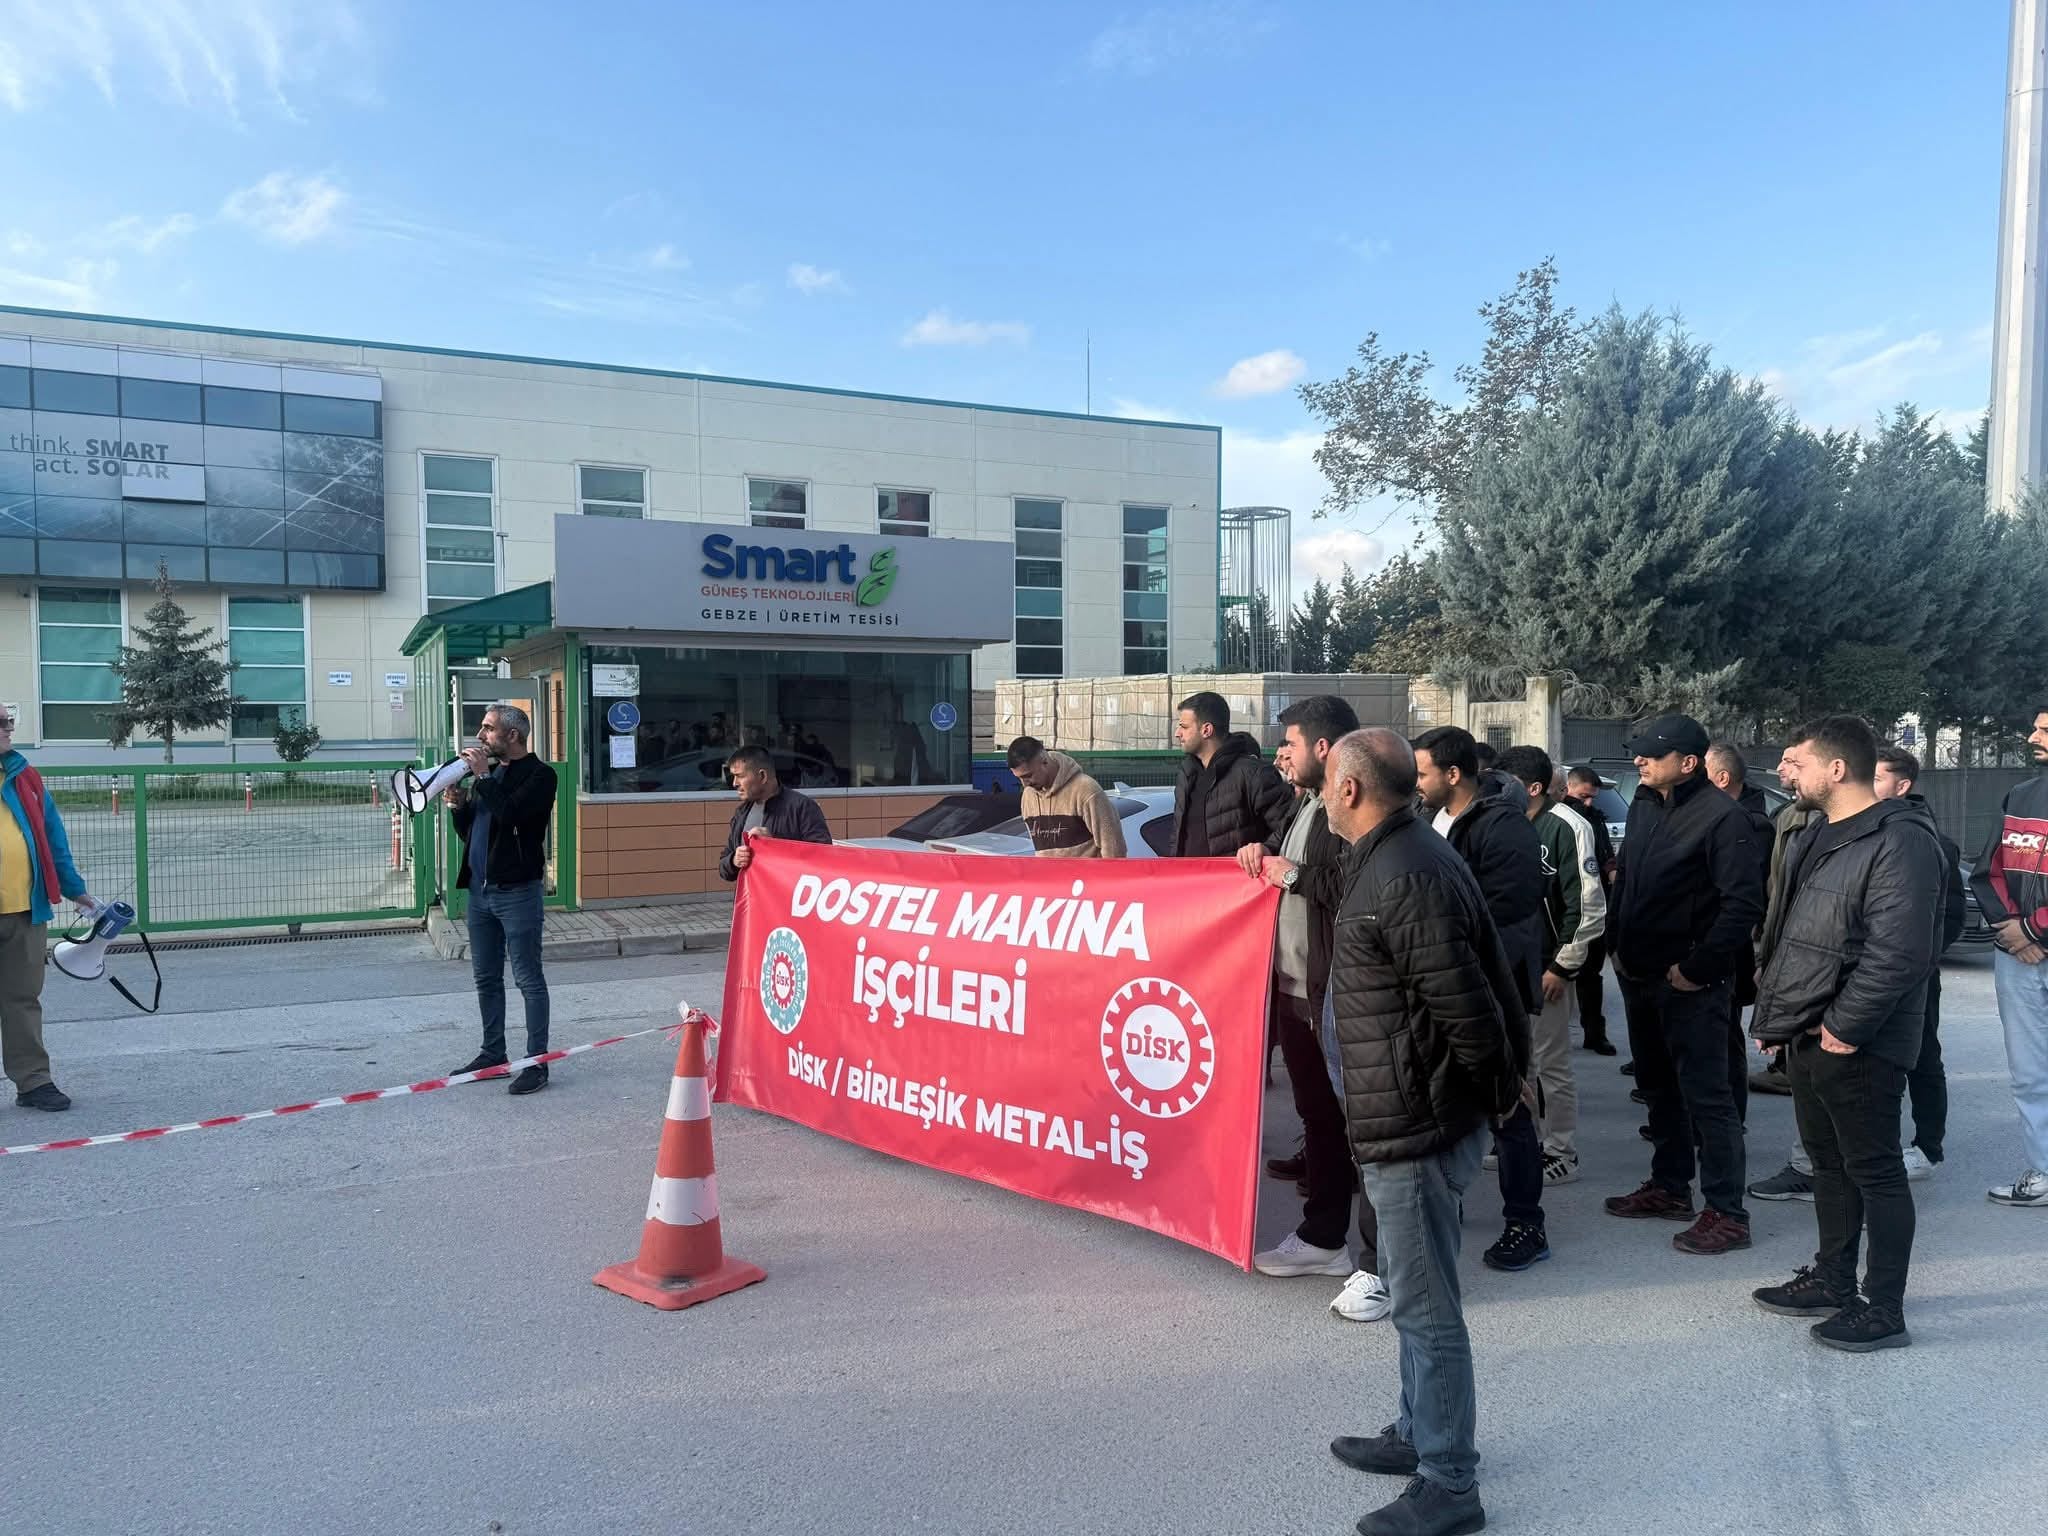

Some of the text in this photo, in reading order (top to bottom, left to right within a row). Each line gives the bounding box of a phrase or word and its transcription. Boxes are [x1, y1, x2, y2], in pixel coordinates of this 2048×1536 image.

[9, 432, 169, 461] think. SMART
[35, 457, 170, 480] act. SOLAR
[702, 533, 857, 585] Smart
[701, 584, 856, 603] GÜNEŞ TEKNOLOJİLERİ
[701, 608, 758, 621] GEBZE
[779, 609, 840, 624] ÜRETİM
[849, 613, 899, 626] TESİSİ
[2001, 832, 2043, 849] LACK
[791, 874, 1152, 962] DOSTEL MAKİNA
[853, 936, 1027, 1036] İŞÇİLERİ
[1125, 1024, 1186, 1064] DİSK
[787, 1041, 828, 1092] DİSK
[847, 1058, 968, 1130] BİRLEŞİK
[975, 1098, 1150, 1181] METAL-İŞ
